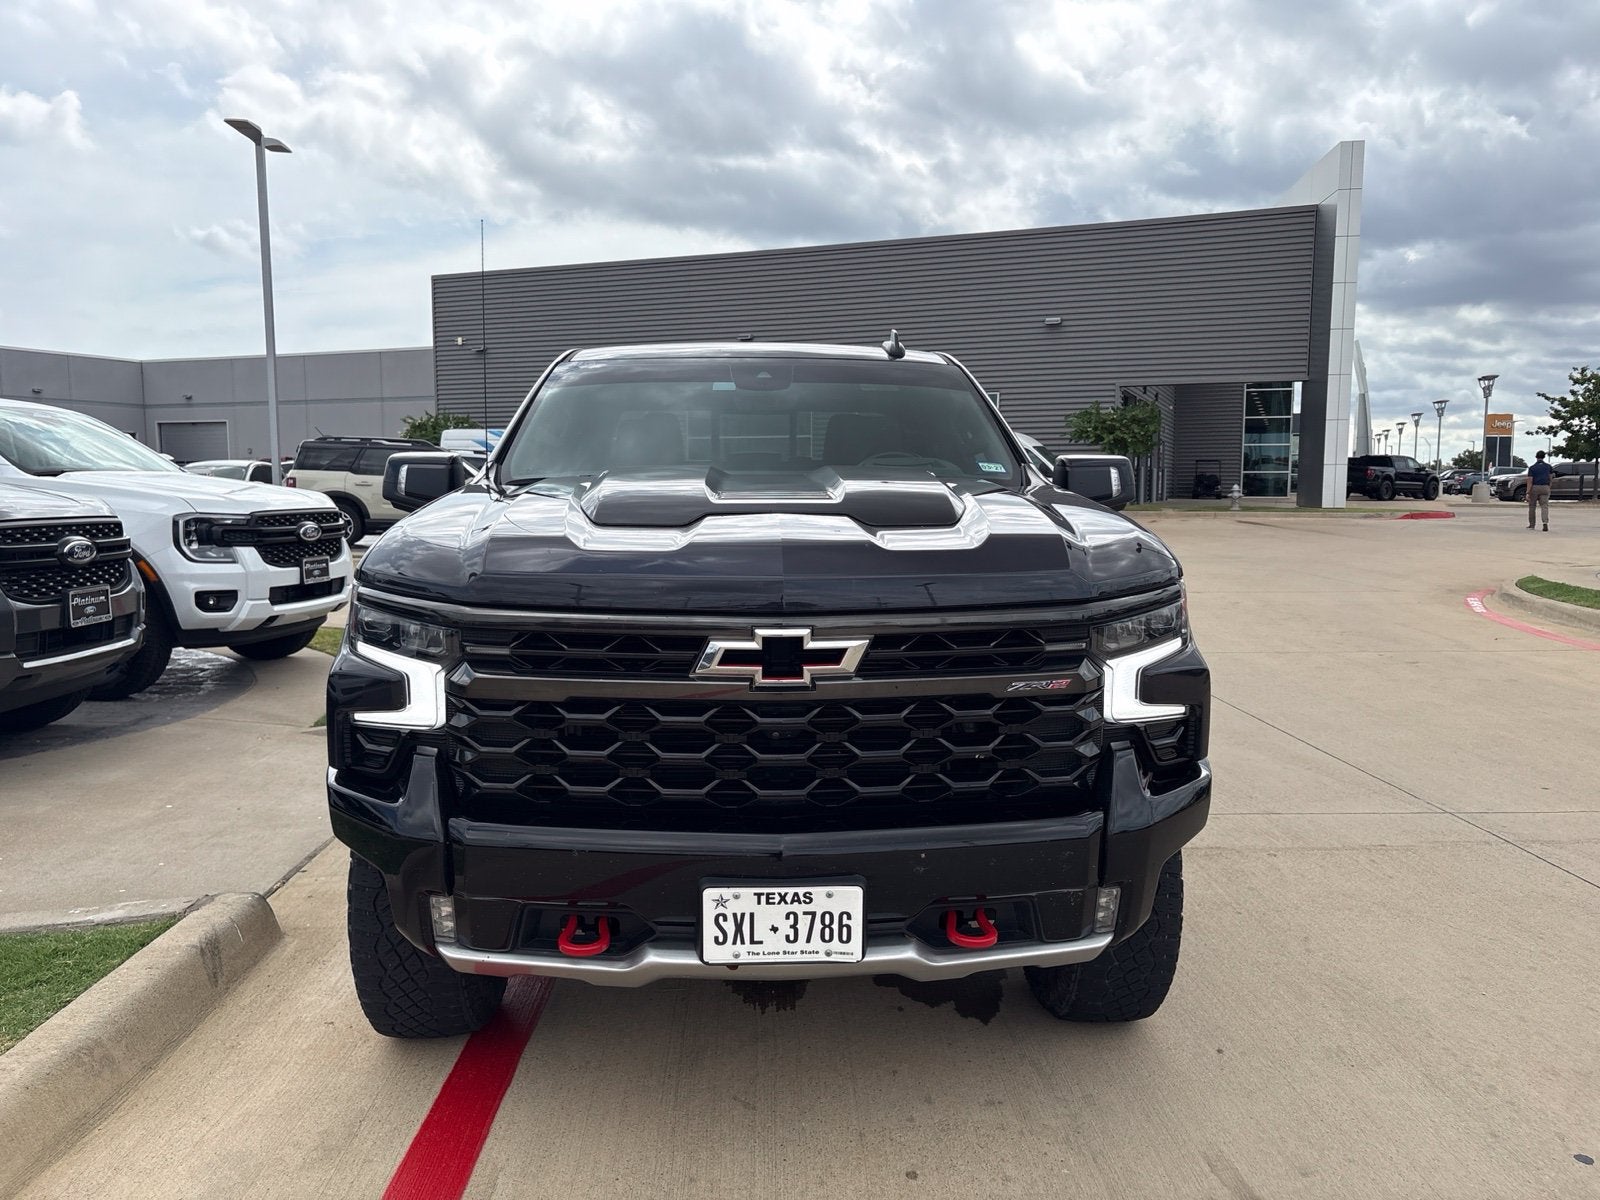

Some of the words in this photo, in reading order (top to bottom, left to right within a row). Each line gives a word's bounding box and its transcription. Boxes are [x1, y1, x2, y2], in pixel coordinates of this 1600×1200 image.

[1491, 419, 1511, 429] Jeep
[73, 544, 92, 558] Ford
[72, 595, 107, 606] Platinum
[753, 891, 814, 906] TEXAS
[713, 911, 764, 946] SXL
[784, 910, 852, 944] 3786
